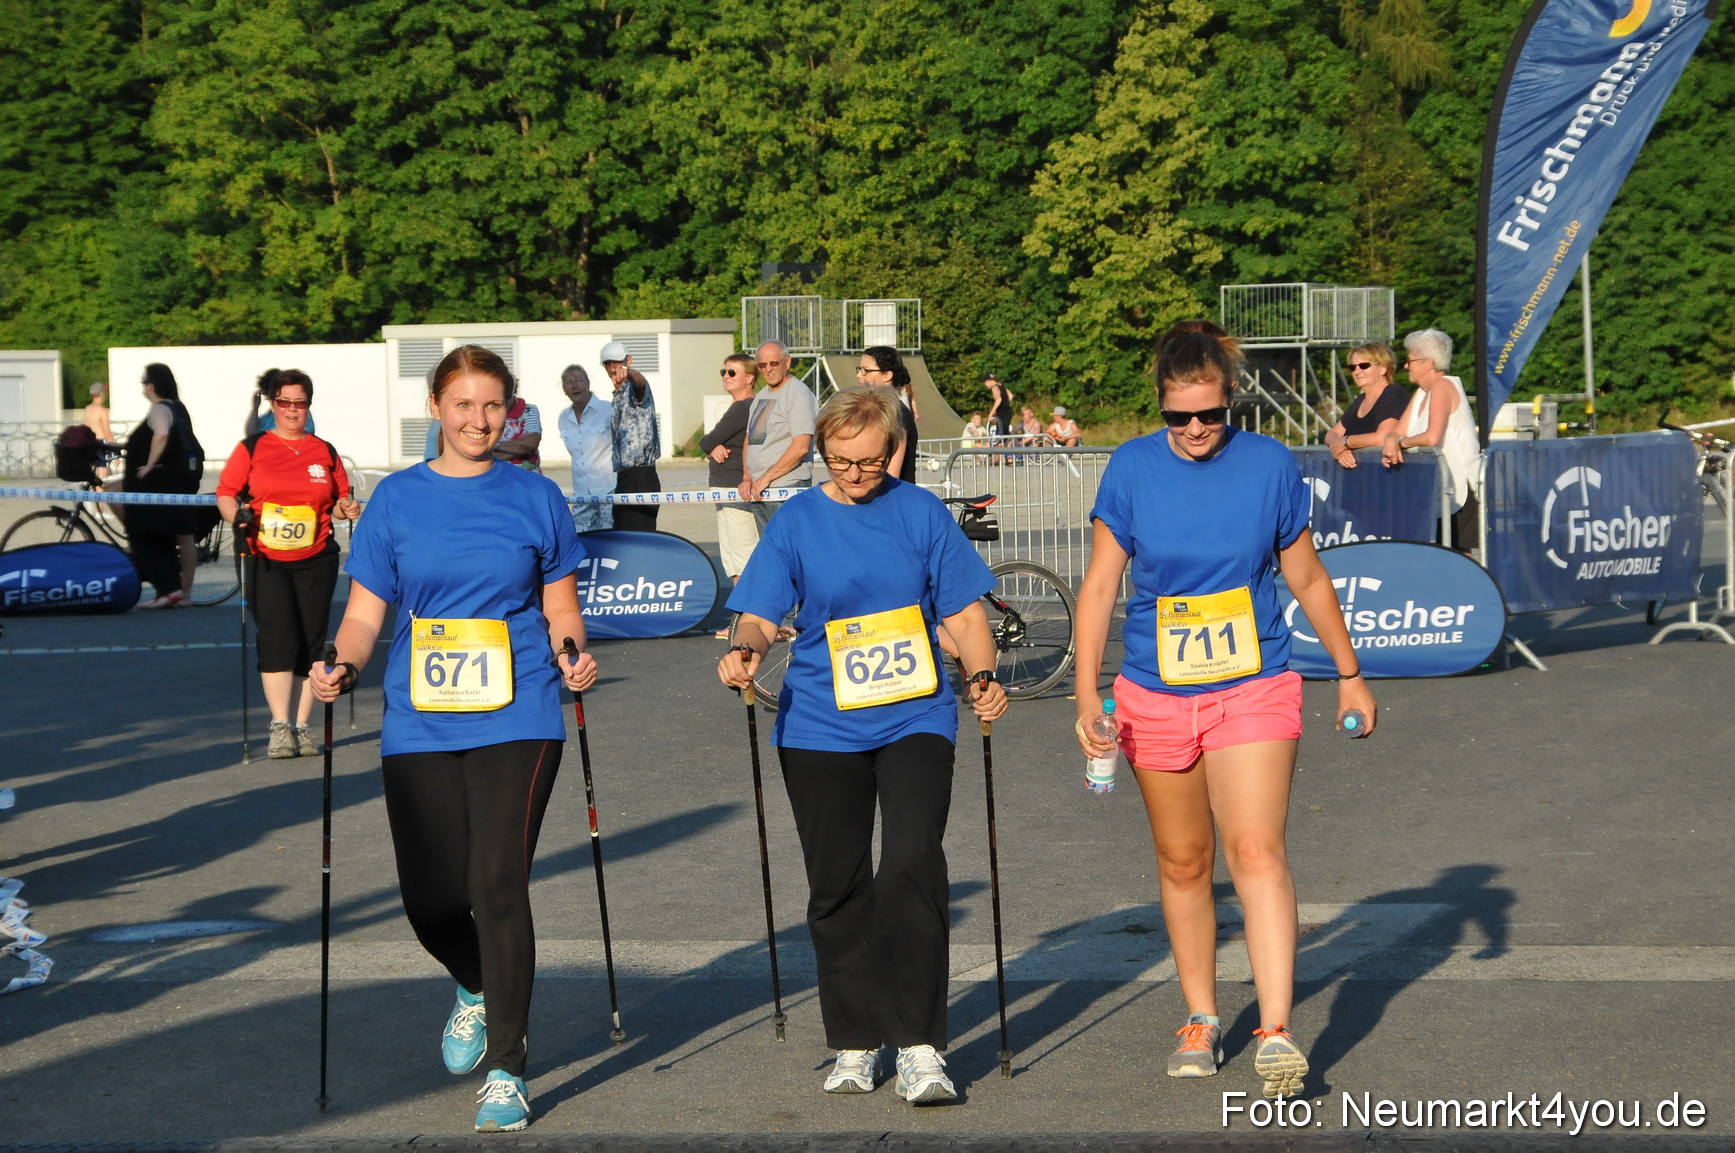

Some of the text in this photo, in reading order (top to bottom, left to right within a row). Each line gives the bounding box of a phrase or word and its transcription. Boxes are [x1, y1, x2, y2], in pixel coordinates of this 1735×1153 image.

[1601, 75, 1639, 126] Druck
[1636, 41, 1662, 73] und
[1497, 42, 1645, 251] Frischmann
[1495, 219, 1582, 374] www.frischmann-net.de
[270, 521, 306, 539] 150
[1568, 505, 1671, 554] Fischer
[1576, 556, 1663, 580] AUTOMOBILE
[4, 576, 117, 606] Fischer
[581, 601, 683, 616] AUTOMOBILE
[1340, 600, 1474, 632] ischer
[1169, 622, 1236, 662] 711
[1351, 631, 1463, 650] UTOMOBILE
[424, 651, 488, 687] 671
[845, 640, 917, 684] 625
[869, 682, 884, 690] Birgit
[885, 687, 907, 695] Neumarkt
